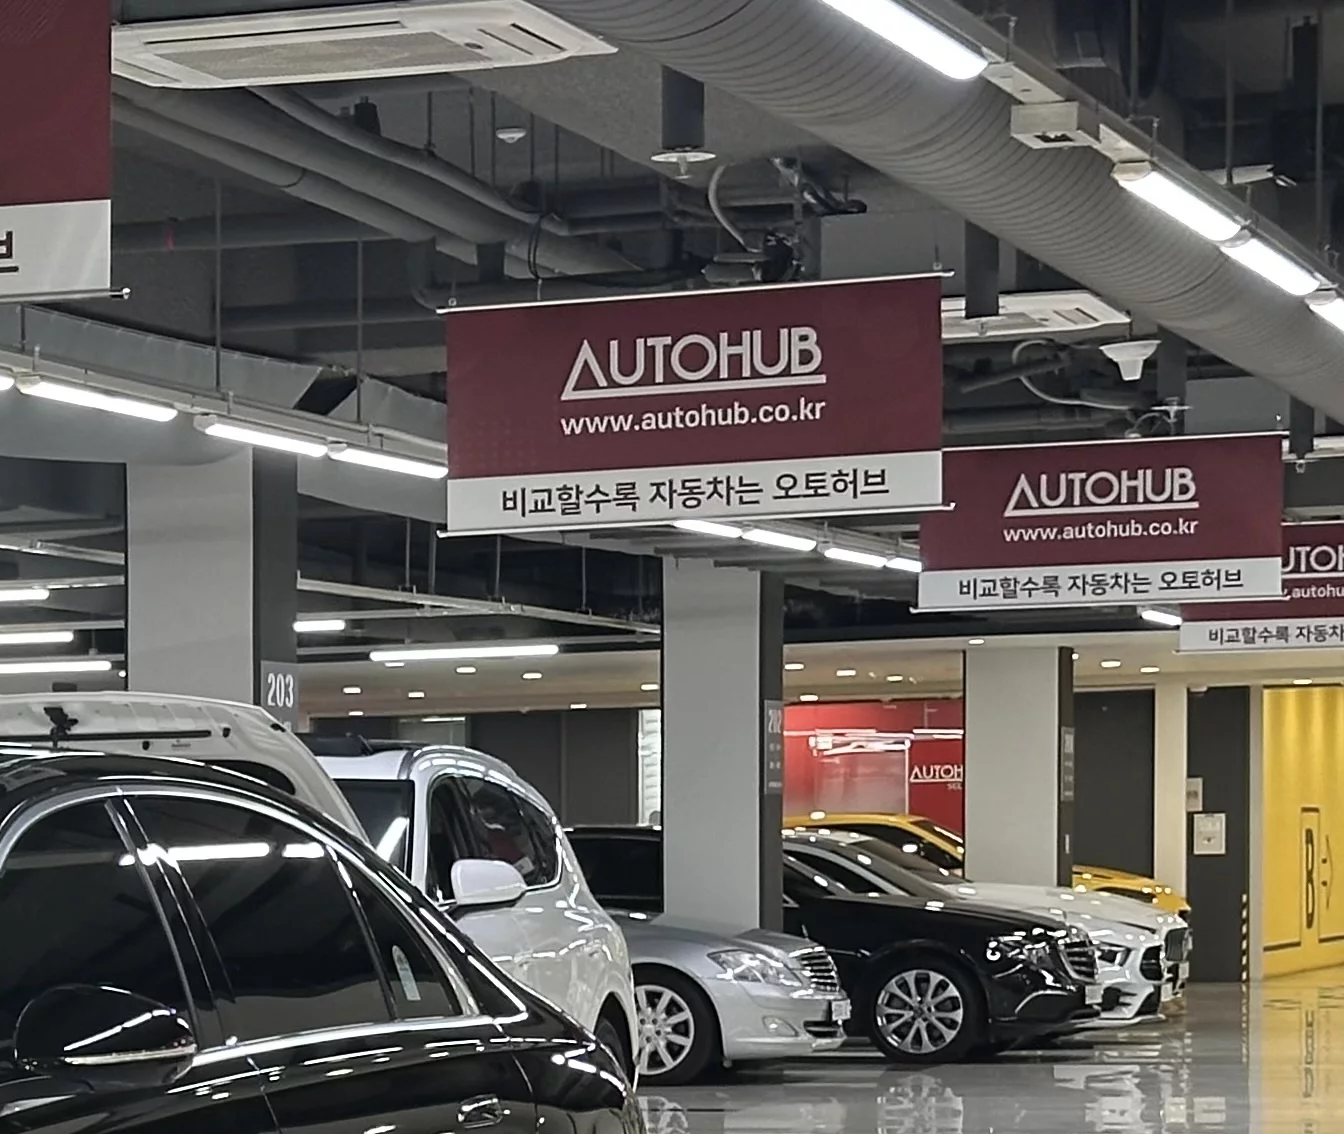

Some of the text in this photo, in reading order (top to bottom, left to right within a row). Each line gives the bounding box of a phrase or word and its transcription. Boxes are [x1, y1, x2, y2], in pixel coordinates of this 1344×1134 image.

[561, 326, 827, 400] AUTOHUB
[561, 398, 826, 436] www.autohub.co.kr
[502, 468, 890, 517] 비교할수록 자동차는 오토허브
[1003, 467, 1200, 517] AUTOHUB
[1003, 518, 1199, 543] www.autohub.co.kr
[958, 568, 1244, 599] 비교할수록 자동차는 오토허브
[1208, 626, 1290, 646] 비교할수록
[267, 673, 294, 708] 203
